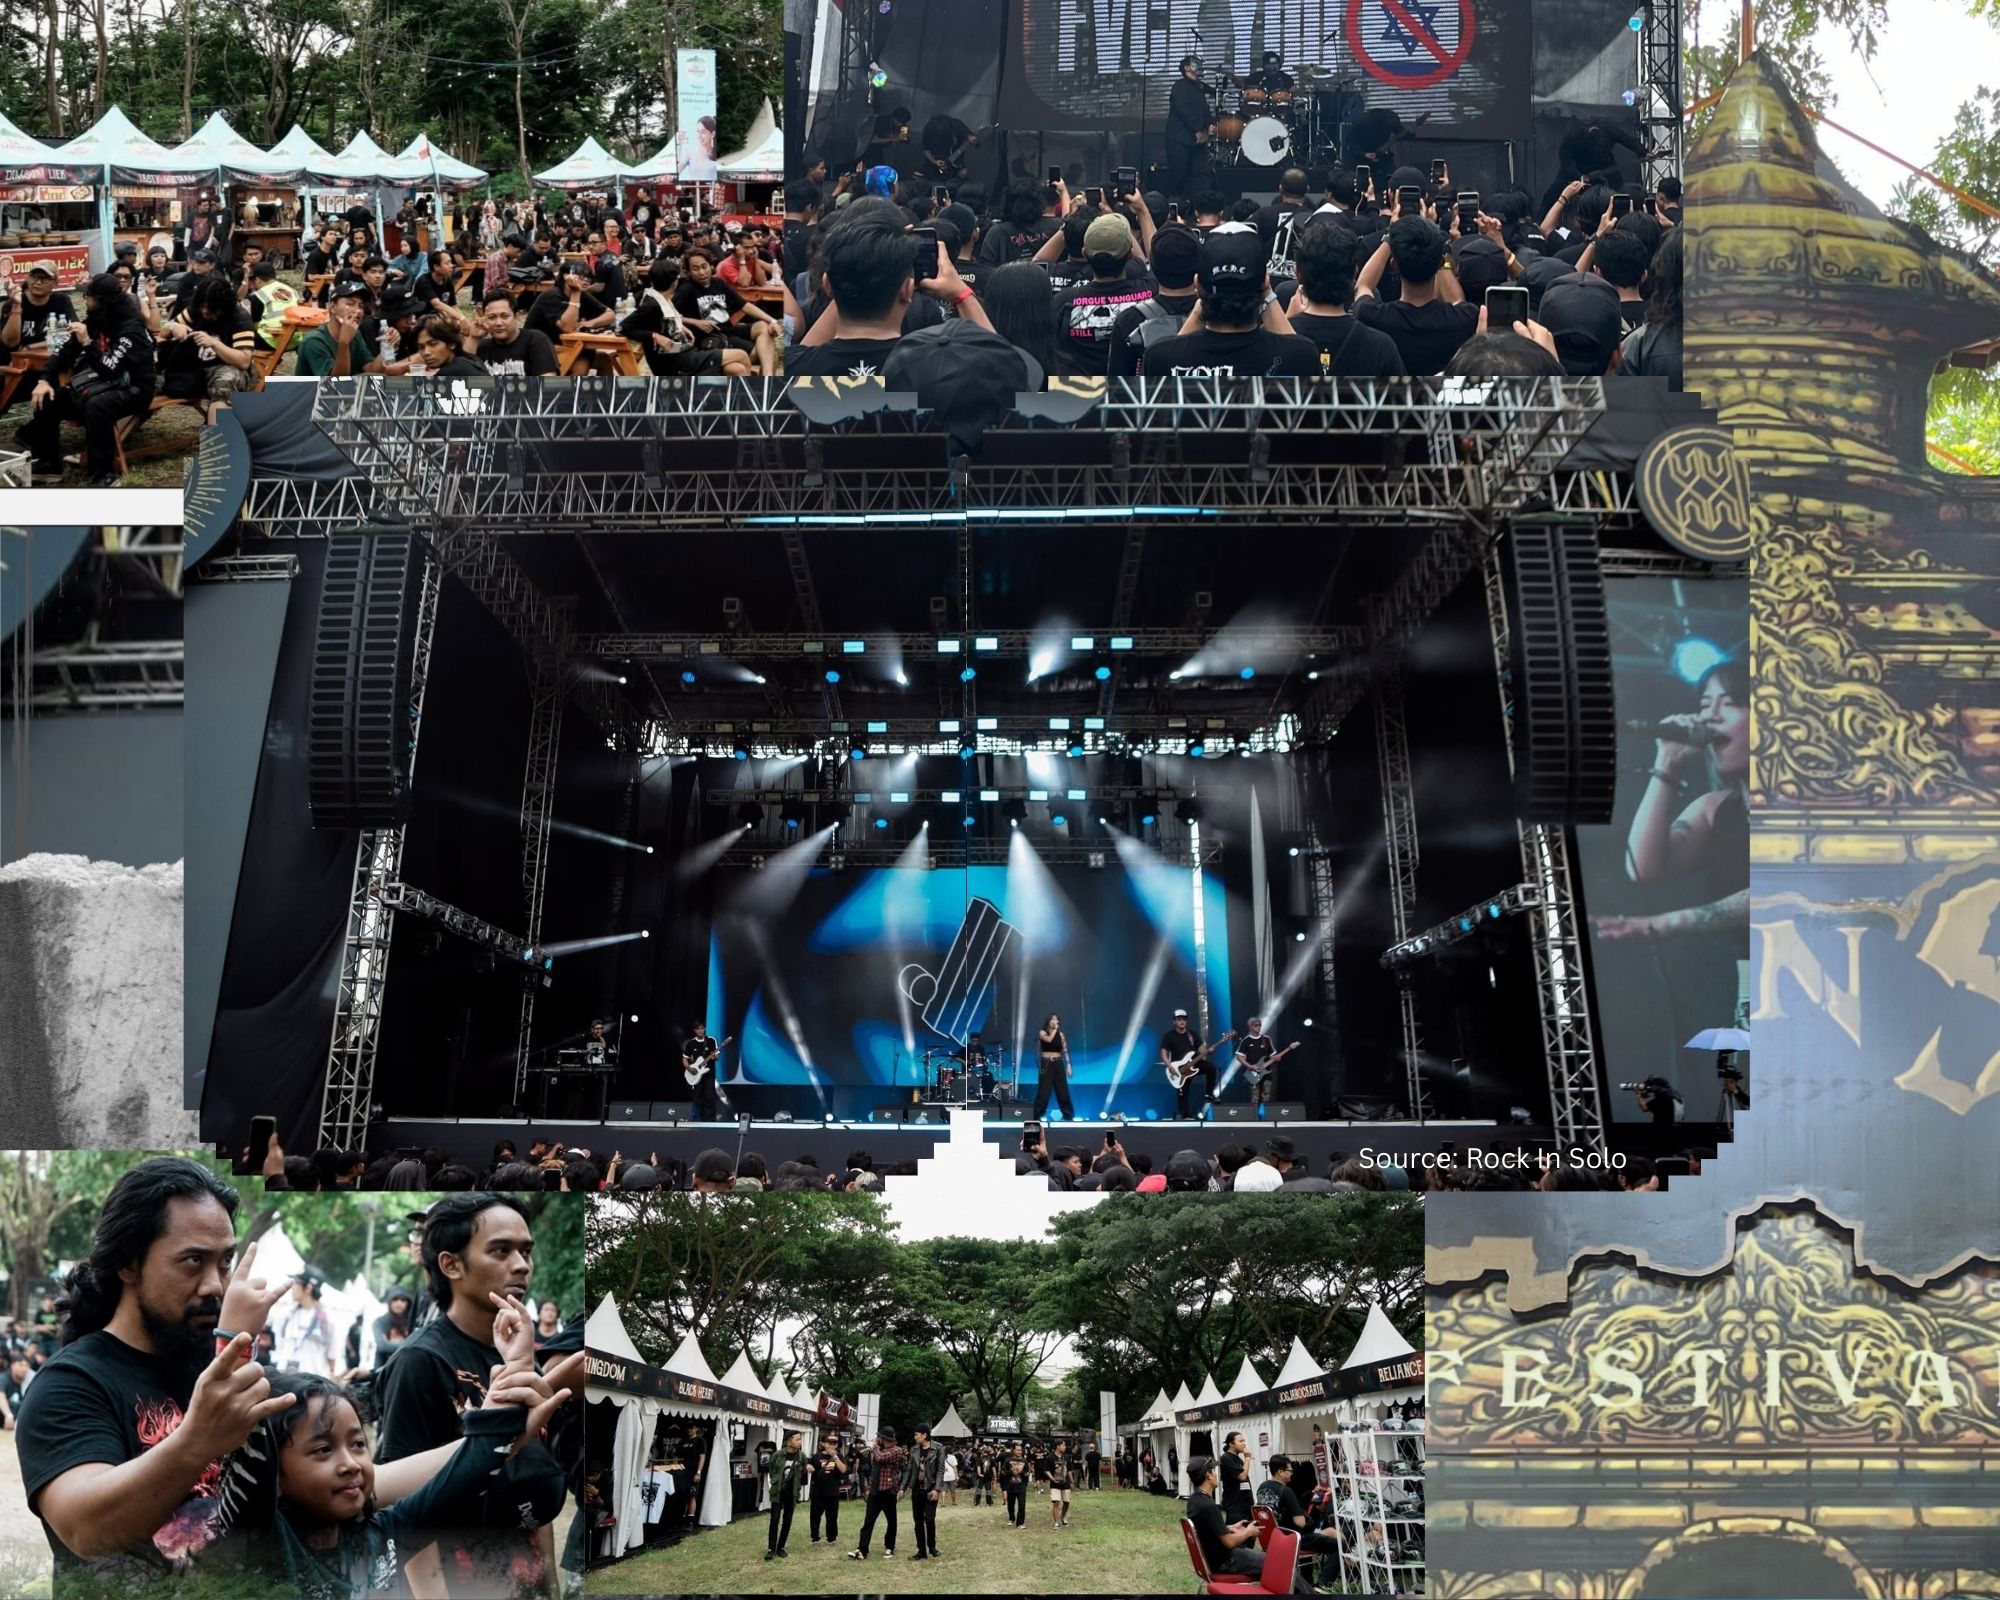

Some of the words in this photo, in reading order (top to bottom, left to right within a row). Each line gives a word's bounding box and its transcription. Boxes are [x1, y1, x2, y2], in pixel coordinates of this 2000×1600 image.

[1107, 290, 1153, 304] VANGUARD
[1069, 328, 1093, 337] STILL
[1377, 1359, 1425, 1383] RELIANCE
[1425, 1347, 2000, 1411] FESTIVA
[679, 1381, 697, 1397] BLACK
[699, 1385, 715, 1400] HEART
[990, 1420, 1018, 1429] XTREME
